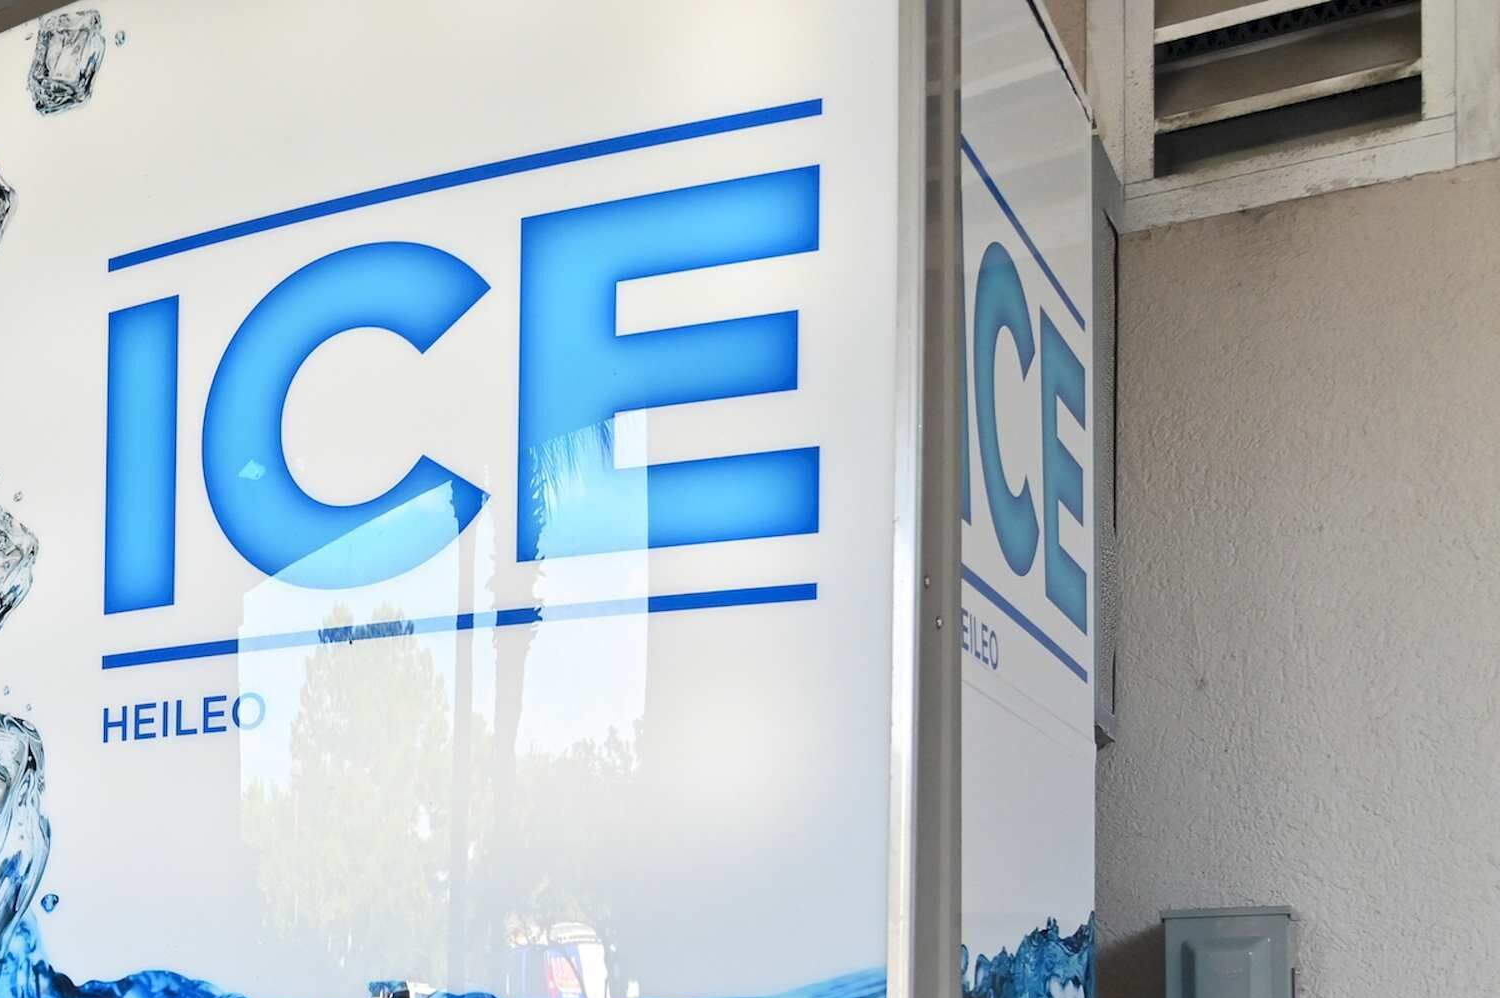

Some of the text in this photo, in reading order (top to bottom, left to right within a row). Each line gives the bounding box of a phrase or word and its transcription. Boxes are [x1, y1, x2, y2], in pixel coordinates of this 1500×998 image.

[104, 164, 820, 615] ICE
[960, 607, 998, 670] EILEO
[102, 691, 266, 744] HEILEO
